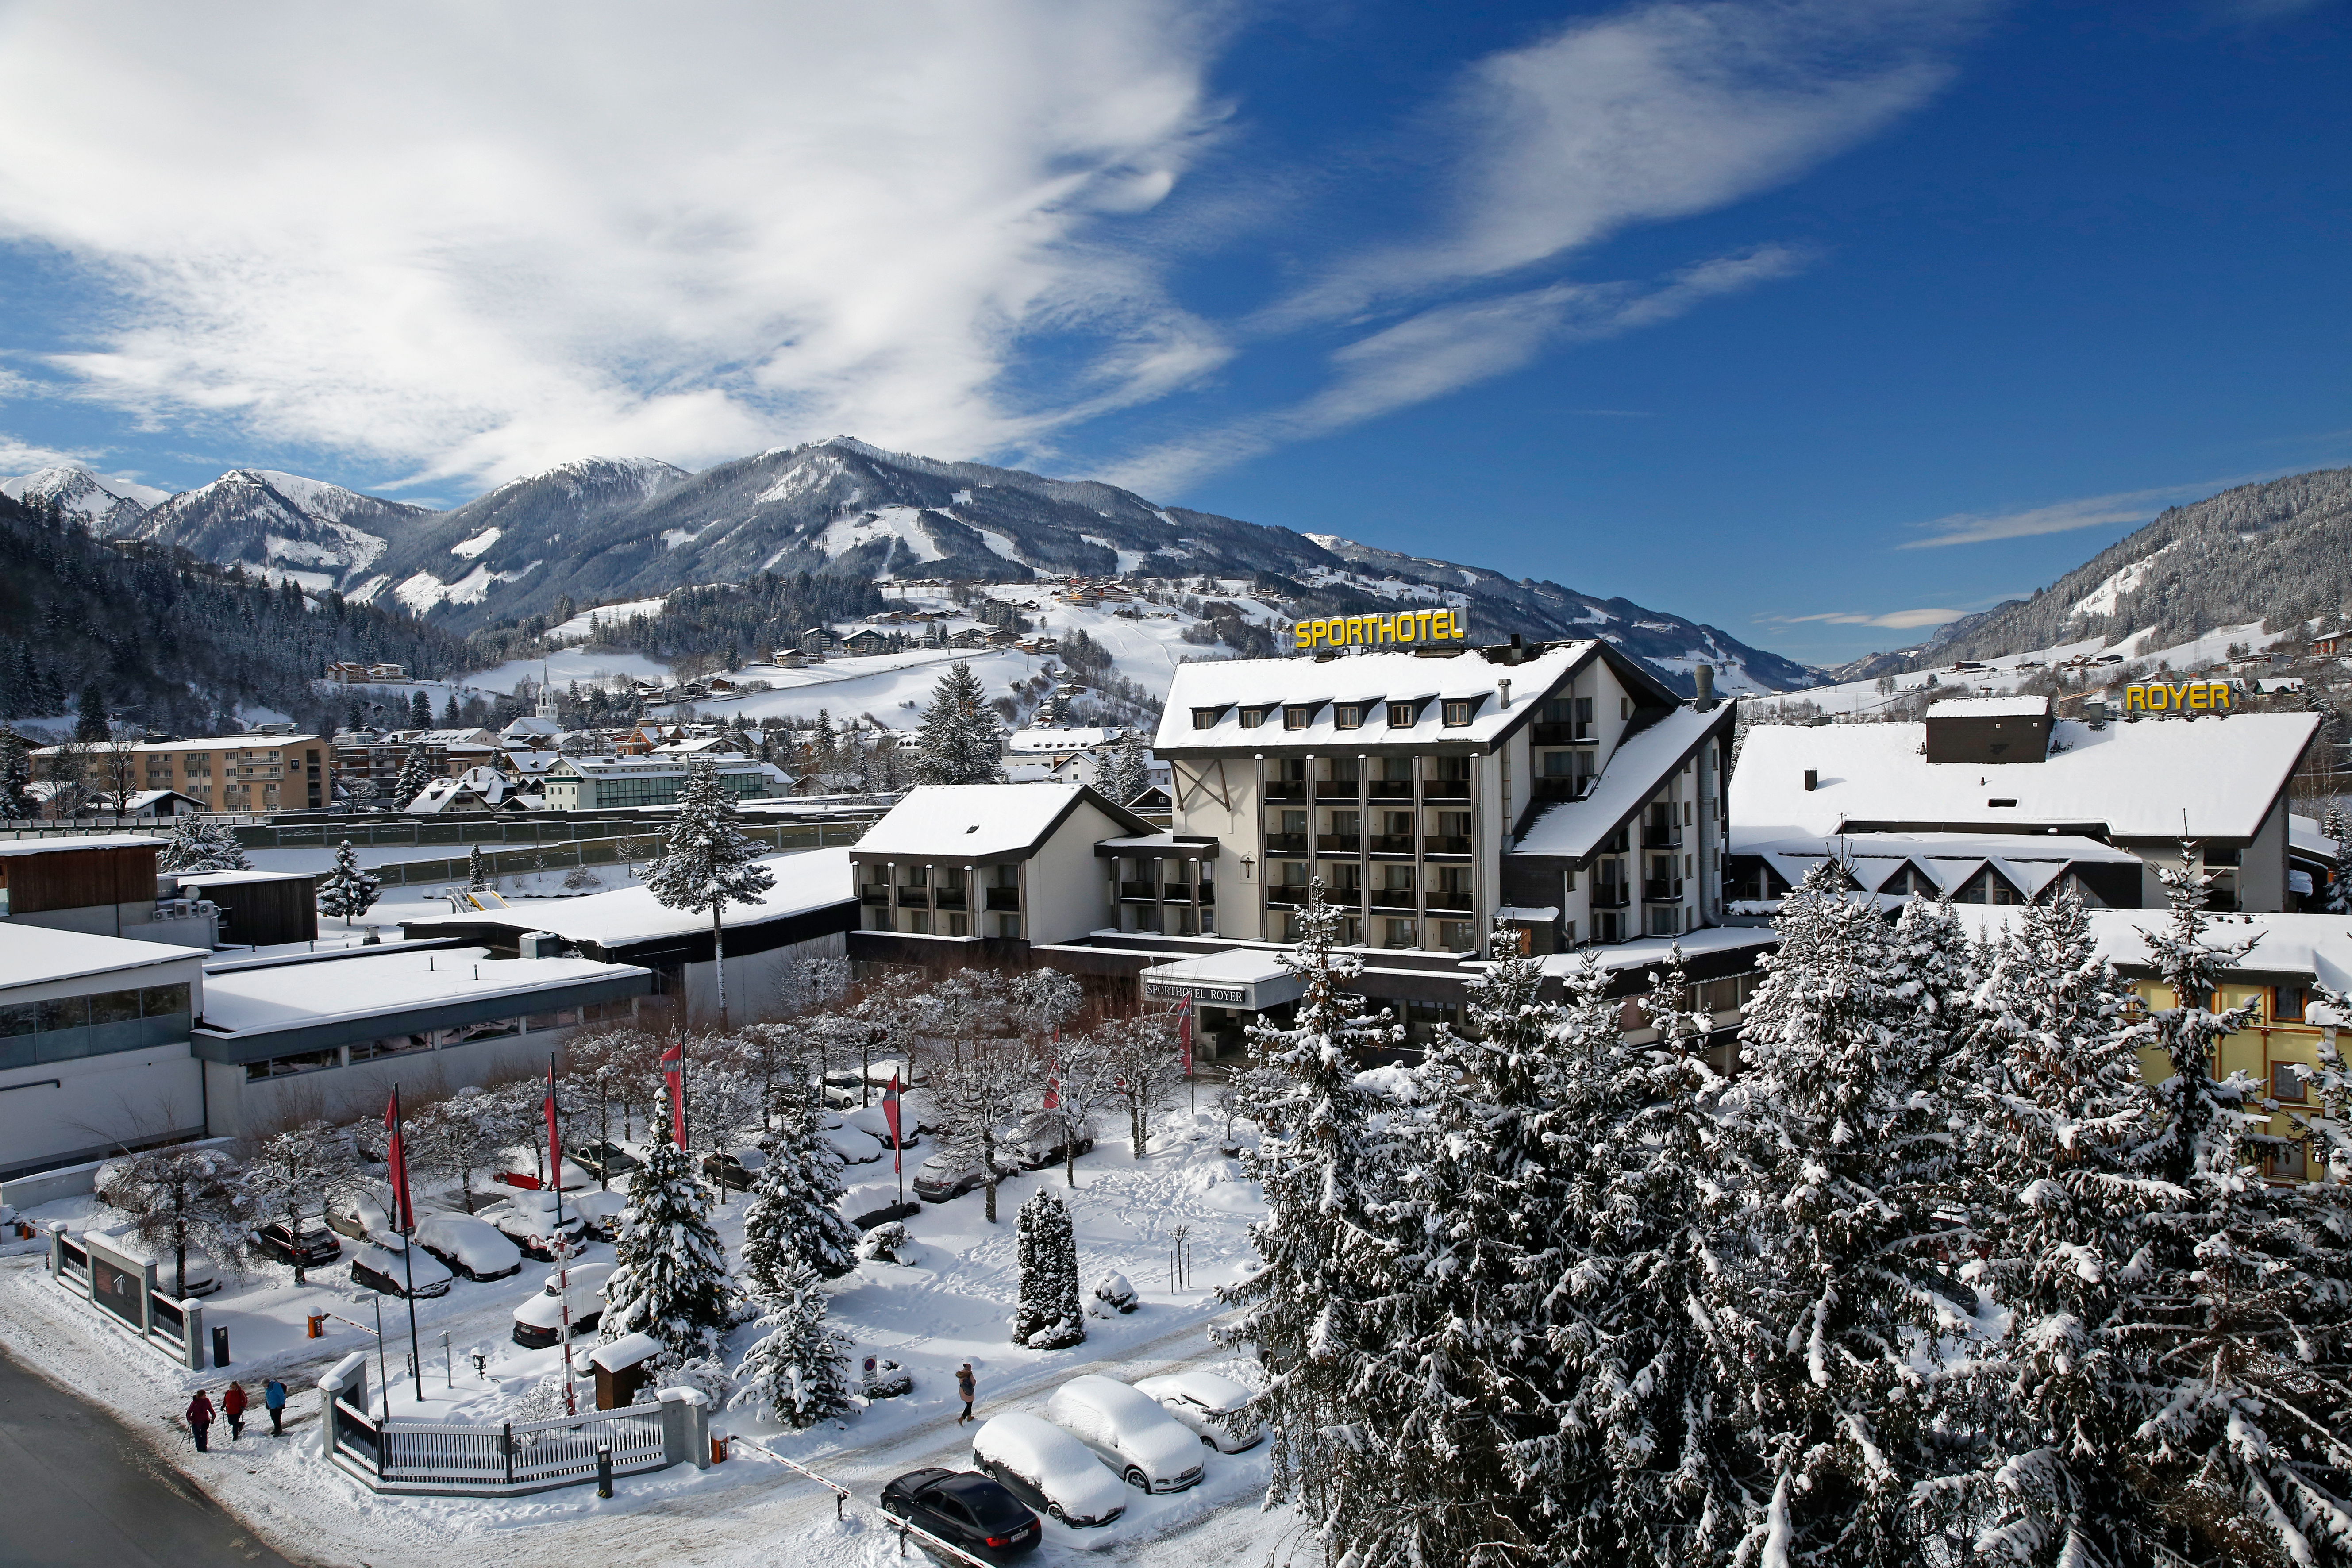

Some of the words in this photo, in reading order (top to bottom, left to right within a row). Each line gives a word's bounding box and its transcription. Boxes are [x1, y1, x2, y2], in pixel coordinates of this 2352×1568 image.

[1295, 611, 1463, 648] SPORTHOTEL
[2126, 683, 2230, 710] ROYER
[1147, 984, 1206, 999] SPORTHOTEL
[1210, 990, 1243, 1002] ROYER
